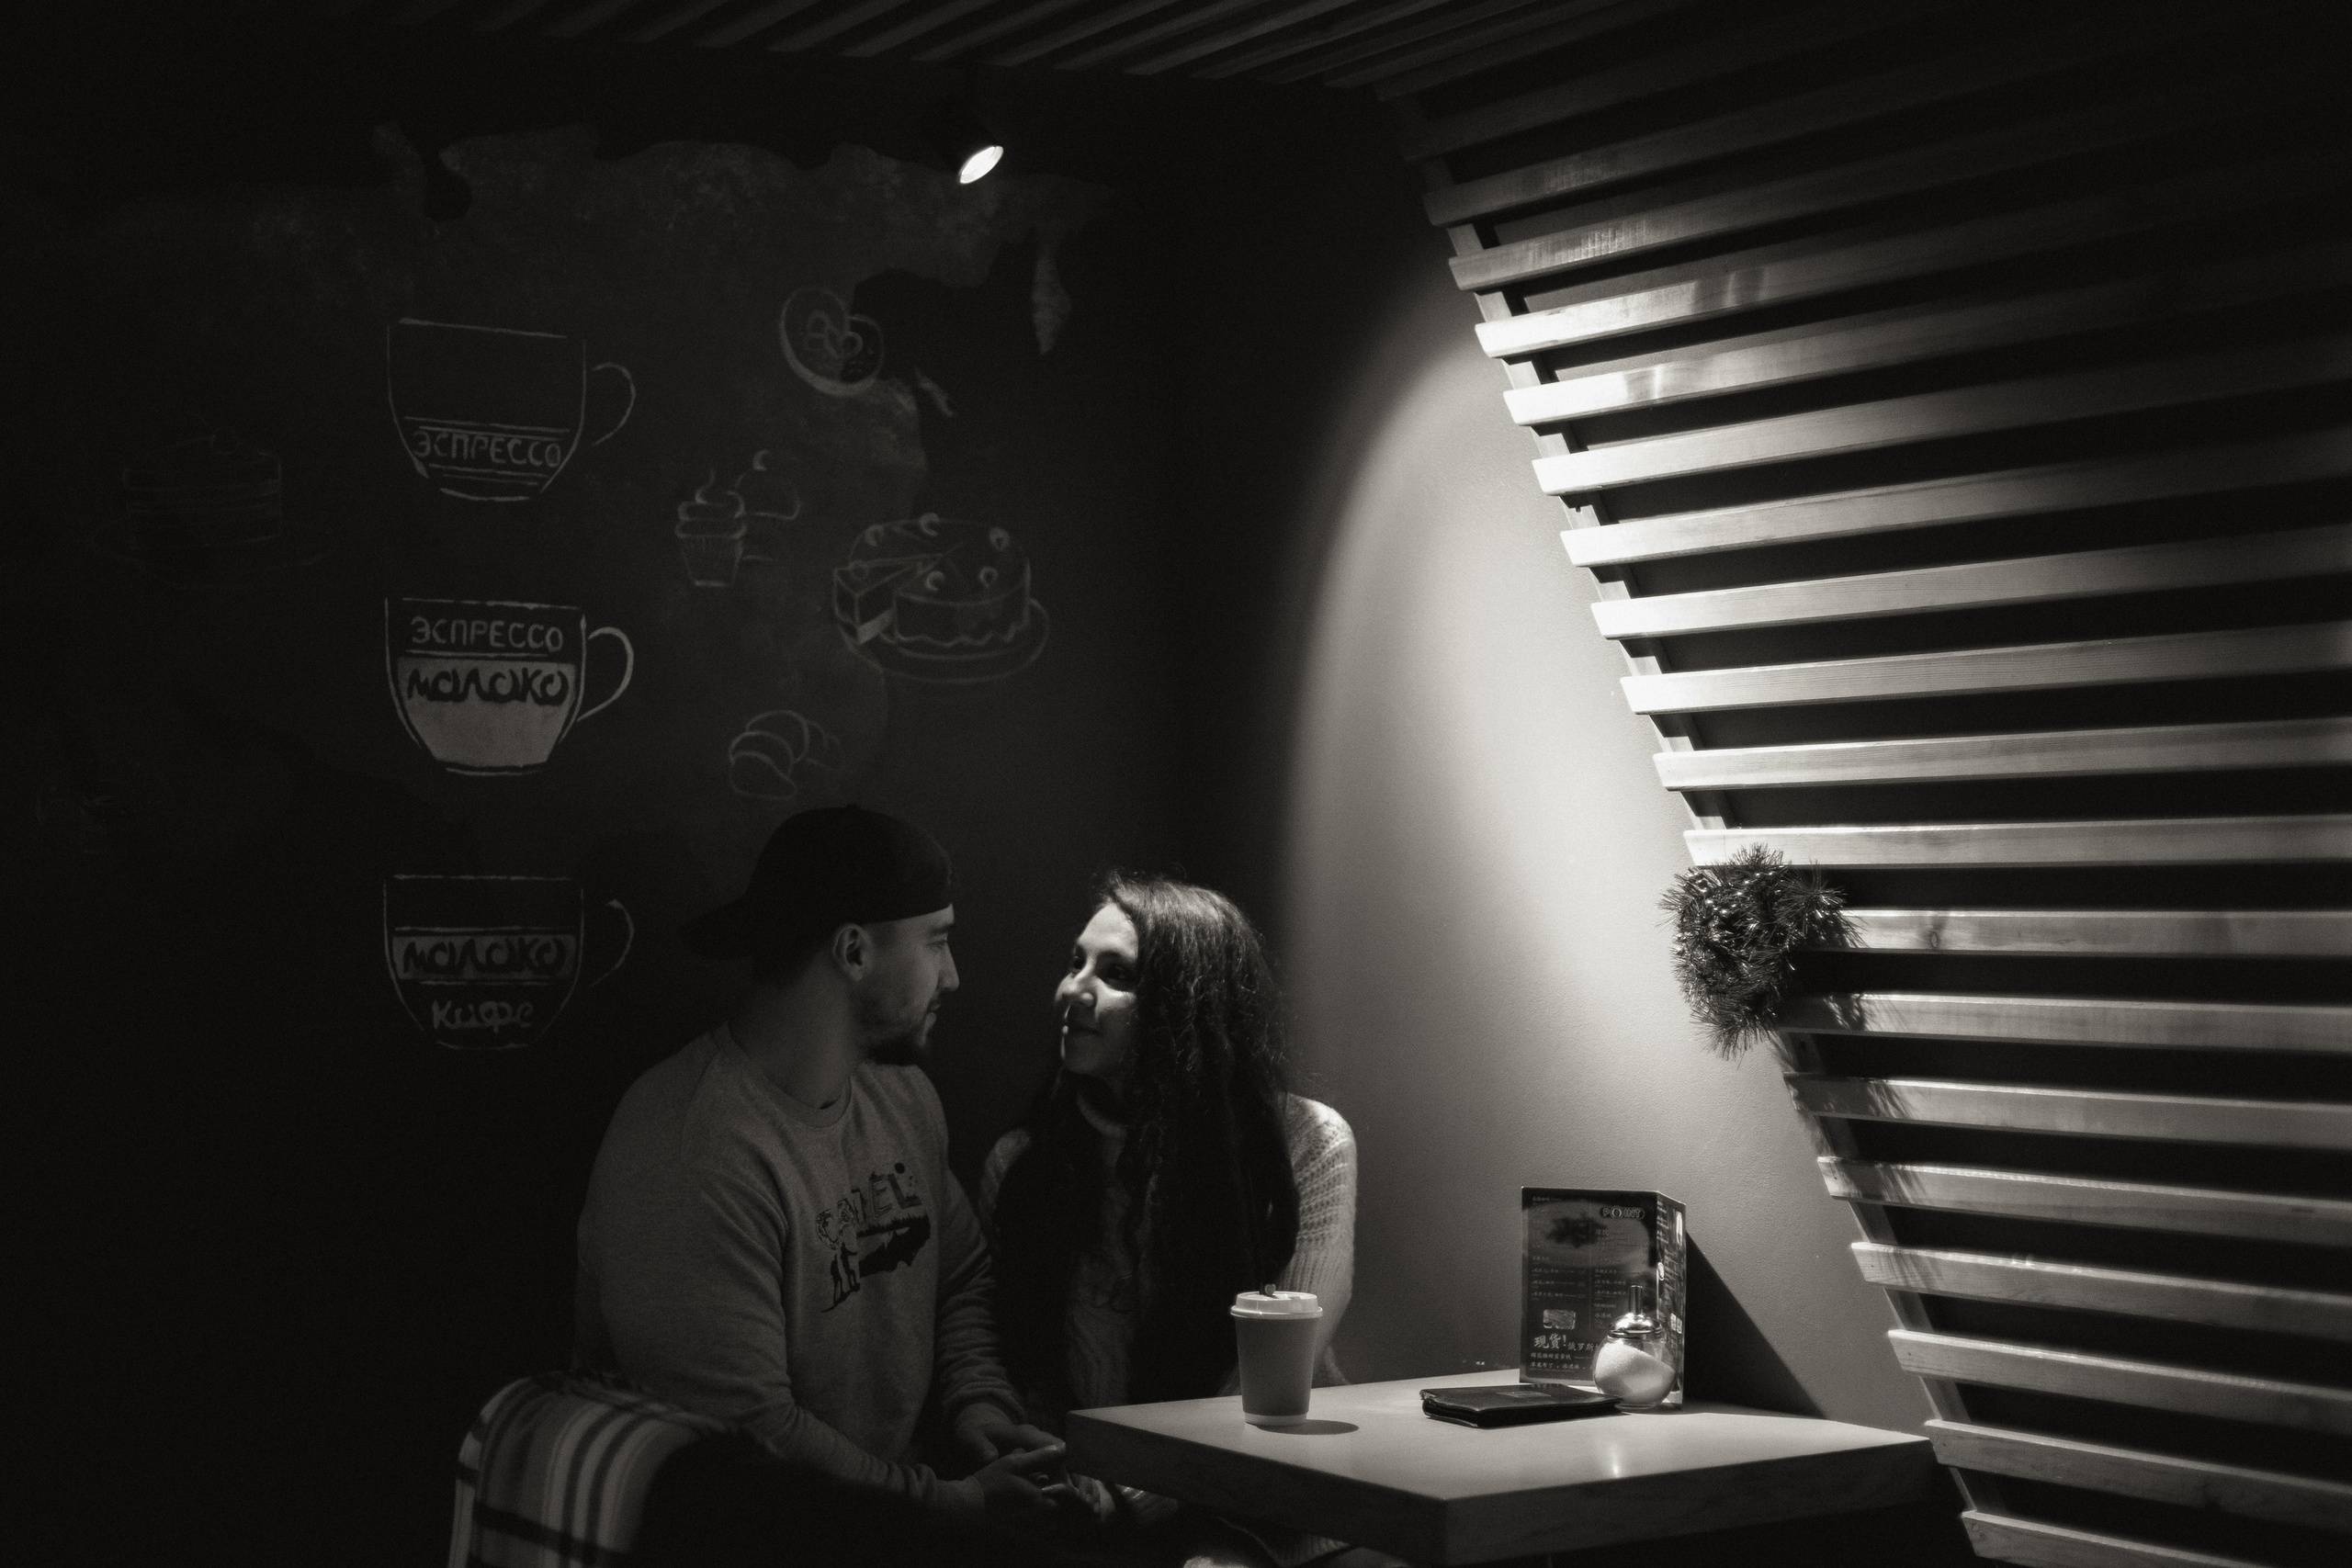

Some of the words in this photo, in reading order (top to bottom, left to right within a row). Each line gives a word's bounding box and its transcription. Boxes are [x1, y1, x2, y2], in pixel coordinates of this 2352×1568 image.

[413, 430, 561, 468] ЭСПРЕССО
[411, 615, 564, 652] ЭСПРЕССО
[1601, 1206, 1642, 1219] POINT
